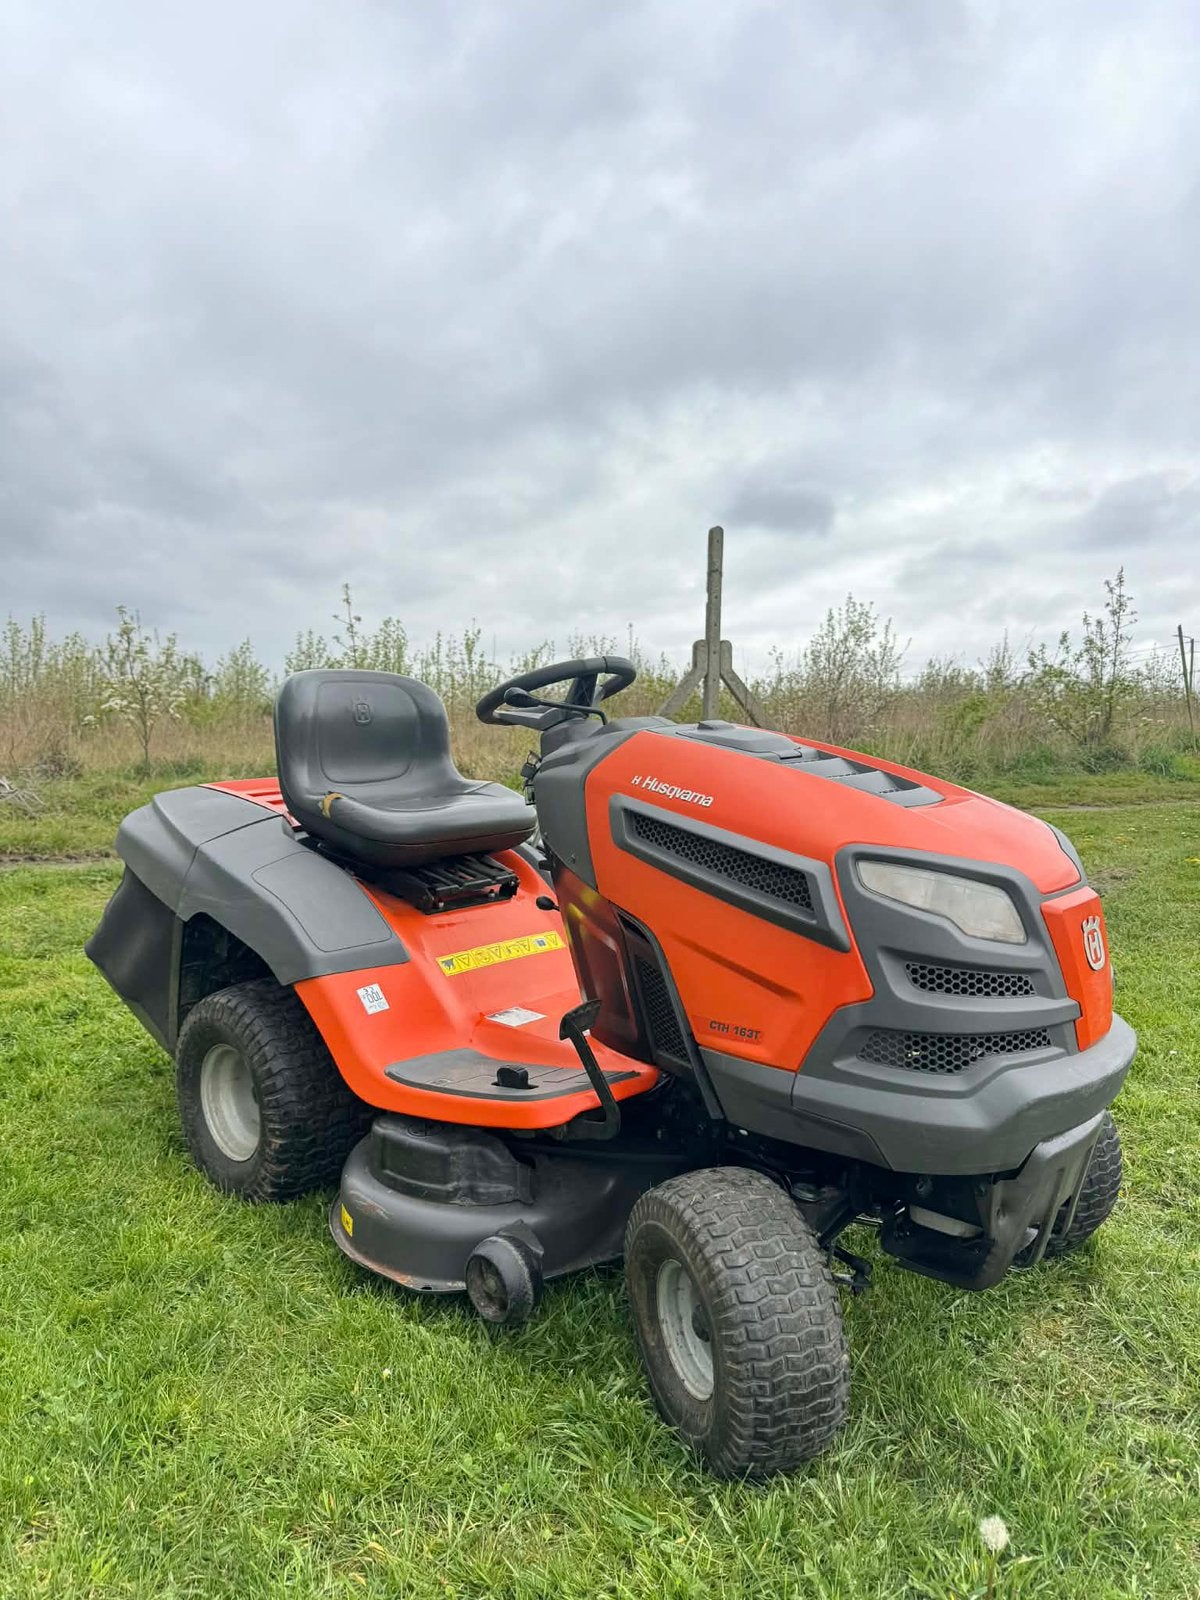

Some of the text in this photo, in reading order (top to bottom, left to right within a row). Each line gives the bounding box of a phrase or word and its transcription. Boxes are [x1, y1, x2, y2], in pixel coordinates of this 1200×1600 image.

[641, 775, 714, 807] Husqvarna
[709, 1020, 760, 1040] CTH 163T
